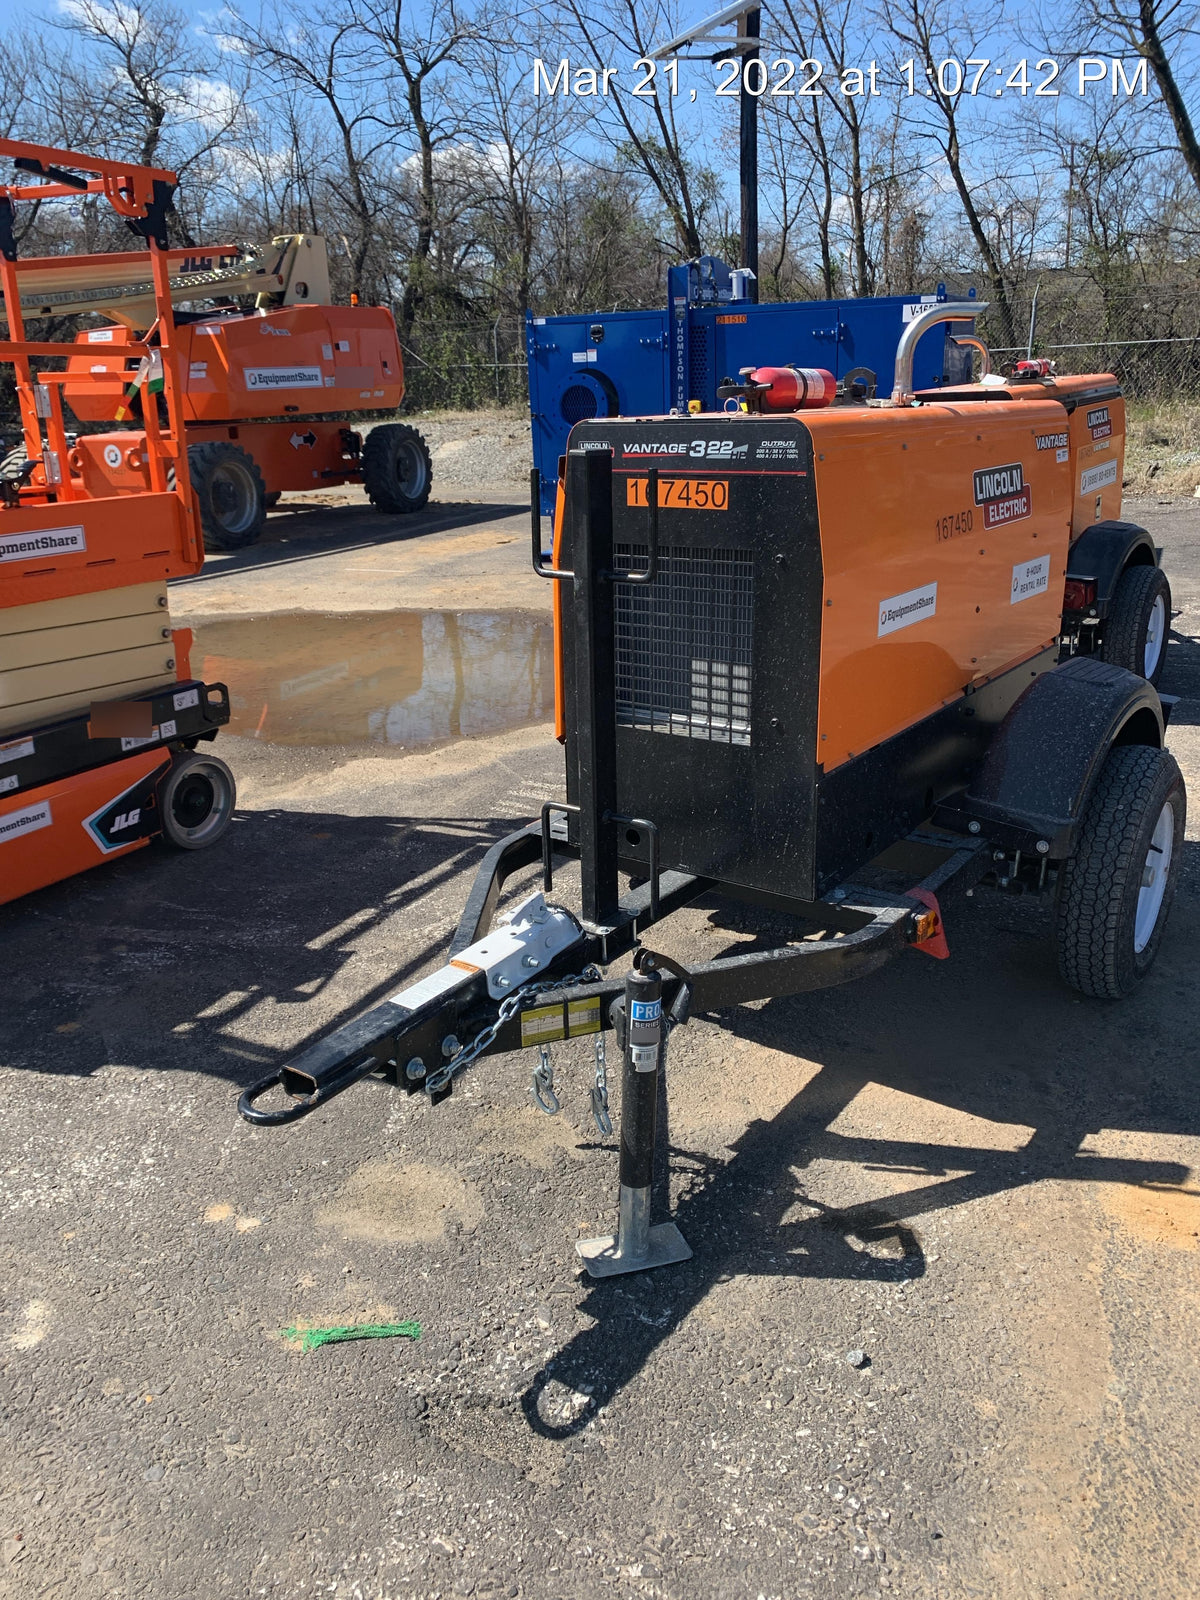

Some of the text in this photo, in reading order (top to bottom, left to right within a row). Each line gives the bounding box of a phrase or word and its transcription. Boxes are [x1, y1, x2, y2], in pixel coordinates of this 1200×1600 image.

[676, 319, 685, 380] THOMPSON
[257, 372, 319, 385] EquipmentShare
[1087, 409, 1109, 427] LINCOLN
[1093, 425, 1111, 438] ELECTRIC
[580, 442, 608, 450] LINCOLN
[623, 443, 687, 454] VANTAGE
[689, 440, 734, 458] 322
[761, 440, 794, 448] OUTPUT
[1035, 433, 1068, 450] VANTAGE
[975, 468, 1021, 500] LINCOLN
[629, 479, 727, 508] 17450
[989, 497, 1027, 523] ELECTRIC
[936, 509, 973, 542] 167450
[887, 596, 934, 621] EquipmentShare
[109, 808, 141, 834] JLG
[635, 1003, 660, 1019] PRO
